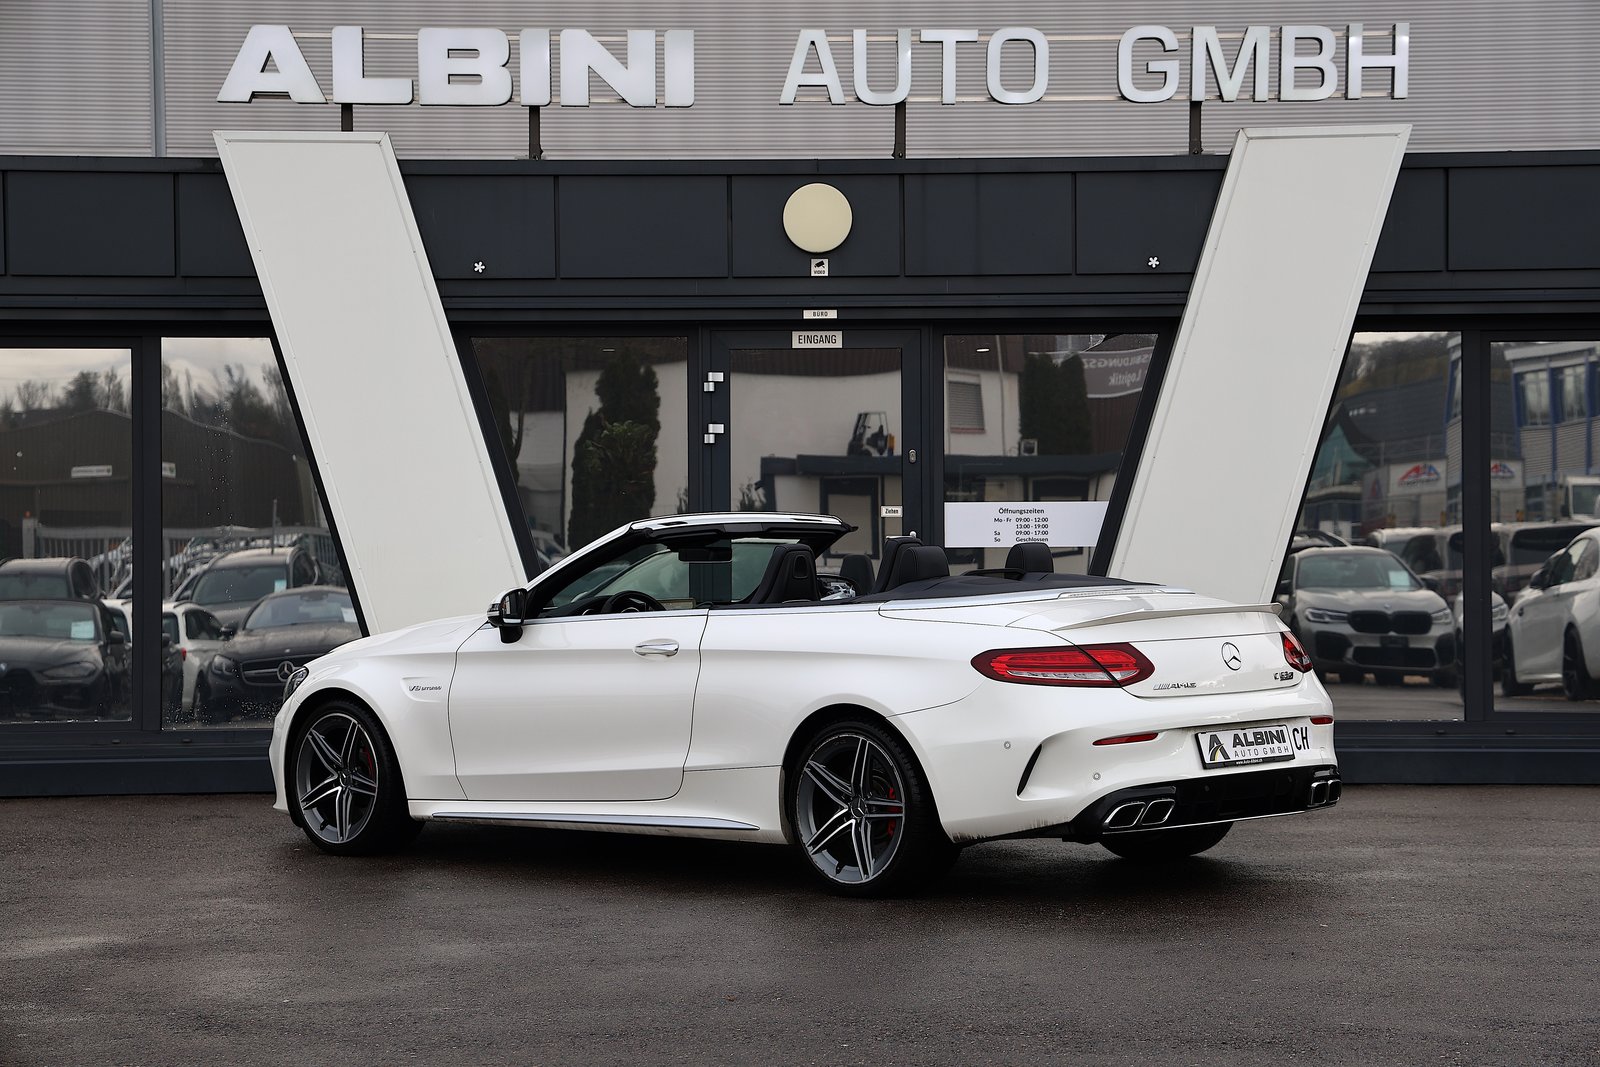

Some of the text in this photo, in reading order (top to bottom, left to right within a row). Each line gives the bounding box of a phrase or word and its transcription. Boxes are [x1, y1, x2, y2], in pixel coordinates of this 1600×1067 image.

[216, 22, 1411, 108] ALBINI AUTO GMBH
[797, 334, 837, 345] EINGANG
[884, 507, 899, 515] Ziehen
[998, 507, 1045, 515] Öffnungszeiten
[1232, 730, 1286, 748] ALBINI
[1292, 727, 1310, 750] CH
[1234, 745, 1290, 758] AUTO GMBH
